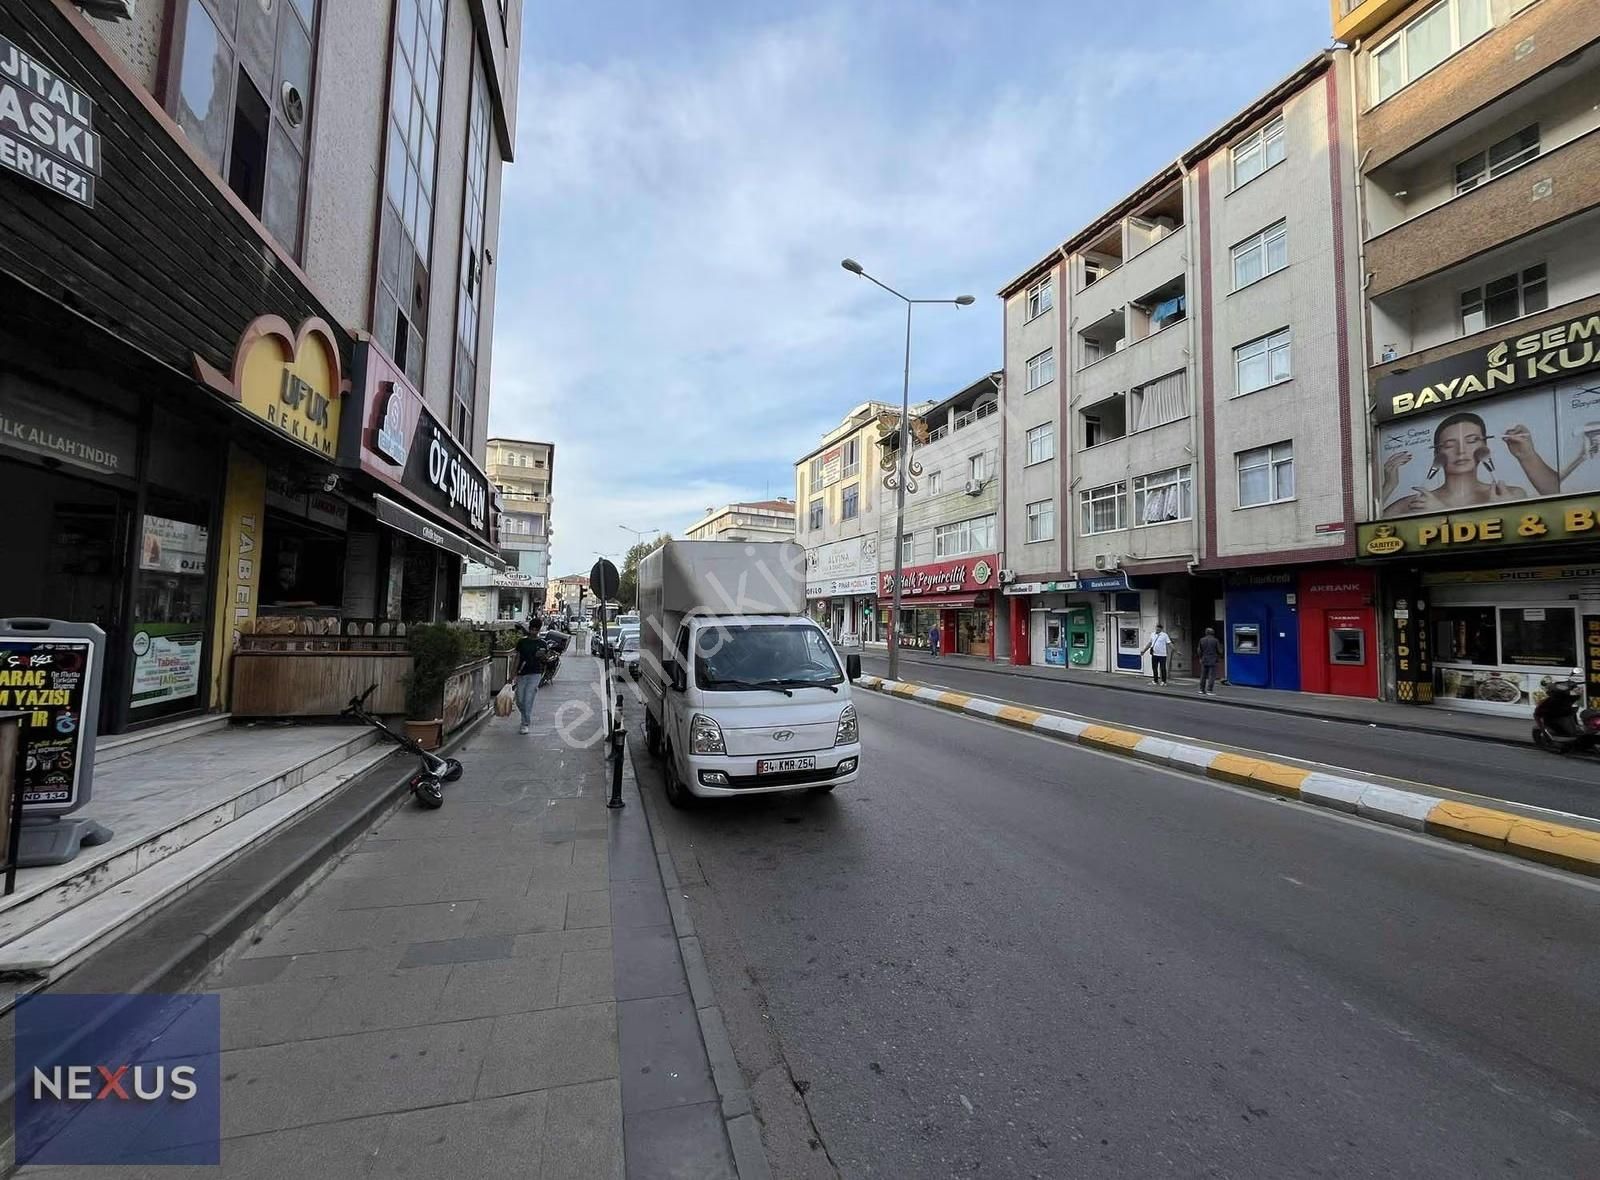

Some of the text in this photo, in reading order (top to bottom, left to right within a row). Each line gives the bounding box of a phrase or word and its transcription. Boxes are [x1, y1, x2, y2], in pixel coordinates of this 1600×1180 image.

[0, 84, 94, 169] ASKI
[0, 134, 87, 201] ERKEZİ
[280, 367, 330, 430] UFUK
[1392, 341, 1600, 415] BAYAN KU
[28, 427, 118, 468] ALLAH'INDIR
[267, 403, 333, 454] REKLAM
[428, 426, 449, 493] ÖZ
[449, 453, 486, 521] ŞİRVAN
[1419, 509, 1600, 546] PİDE & B
[1310, 583, 1360, 592] AKBANK
[0, 669, 46, 688] ARAÇ
[14, 689, 70, 705] YAZISI
[763, 758, 814, 772] 34 KMR 254
